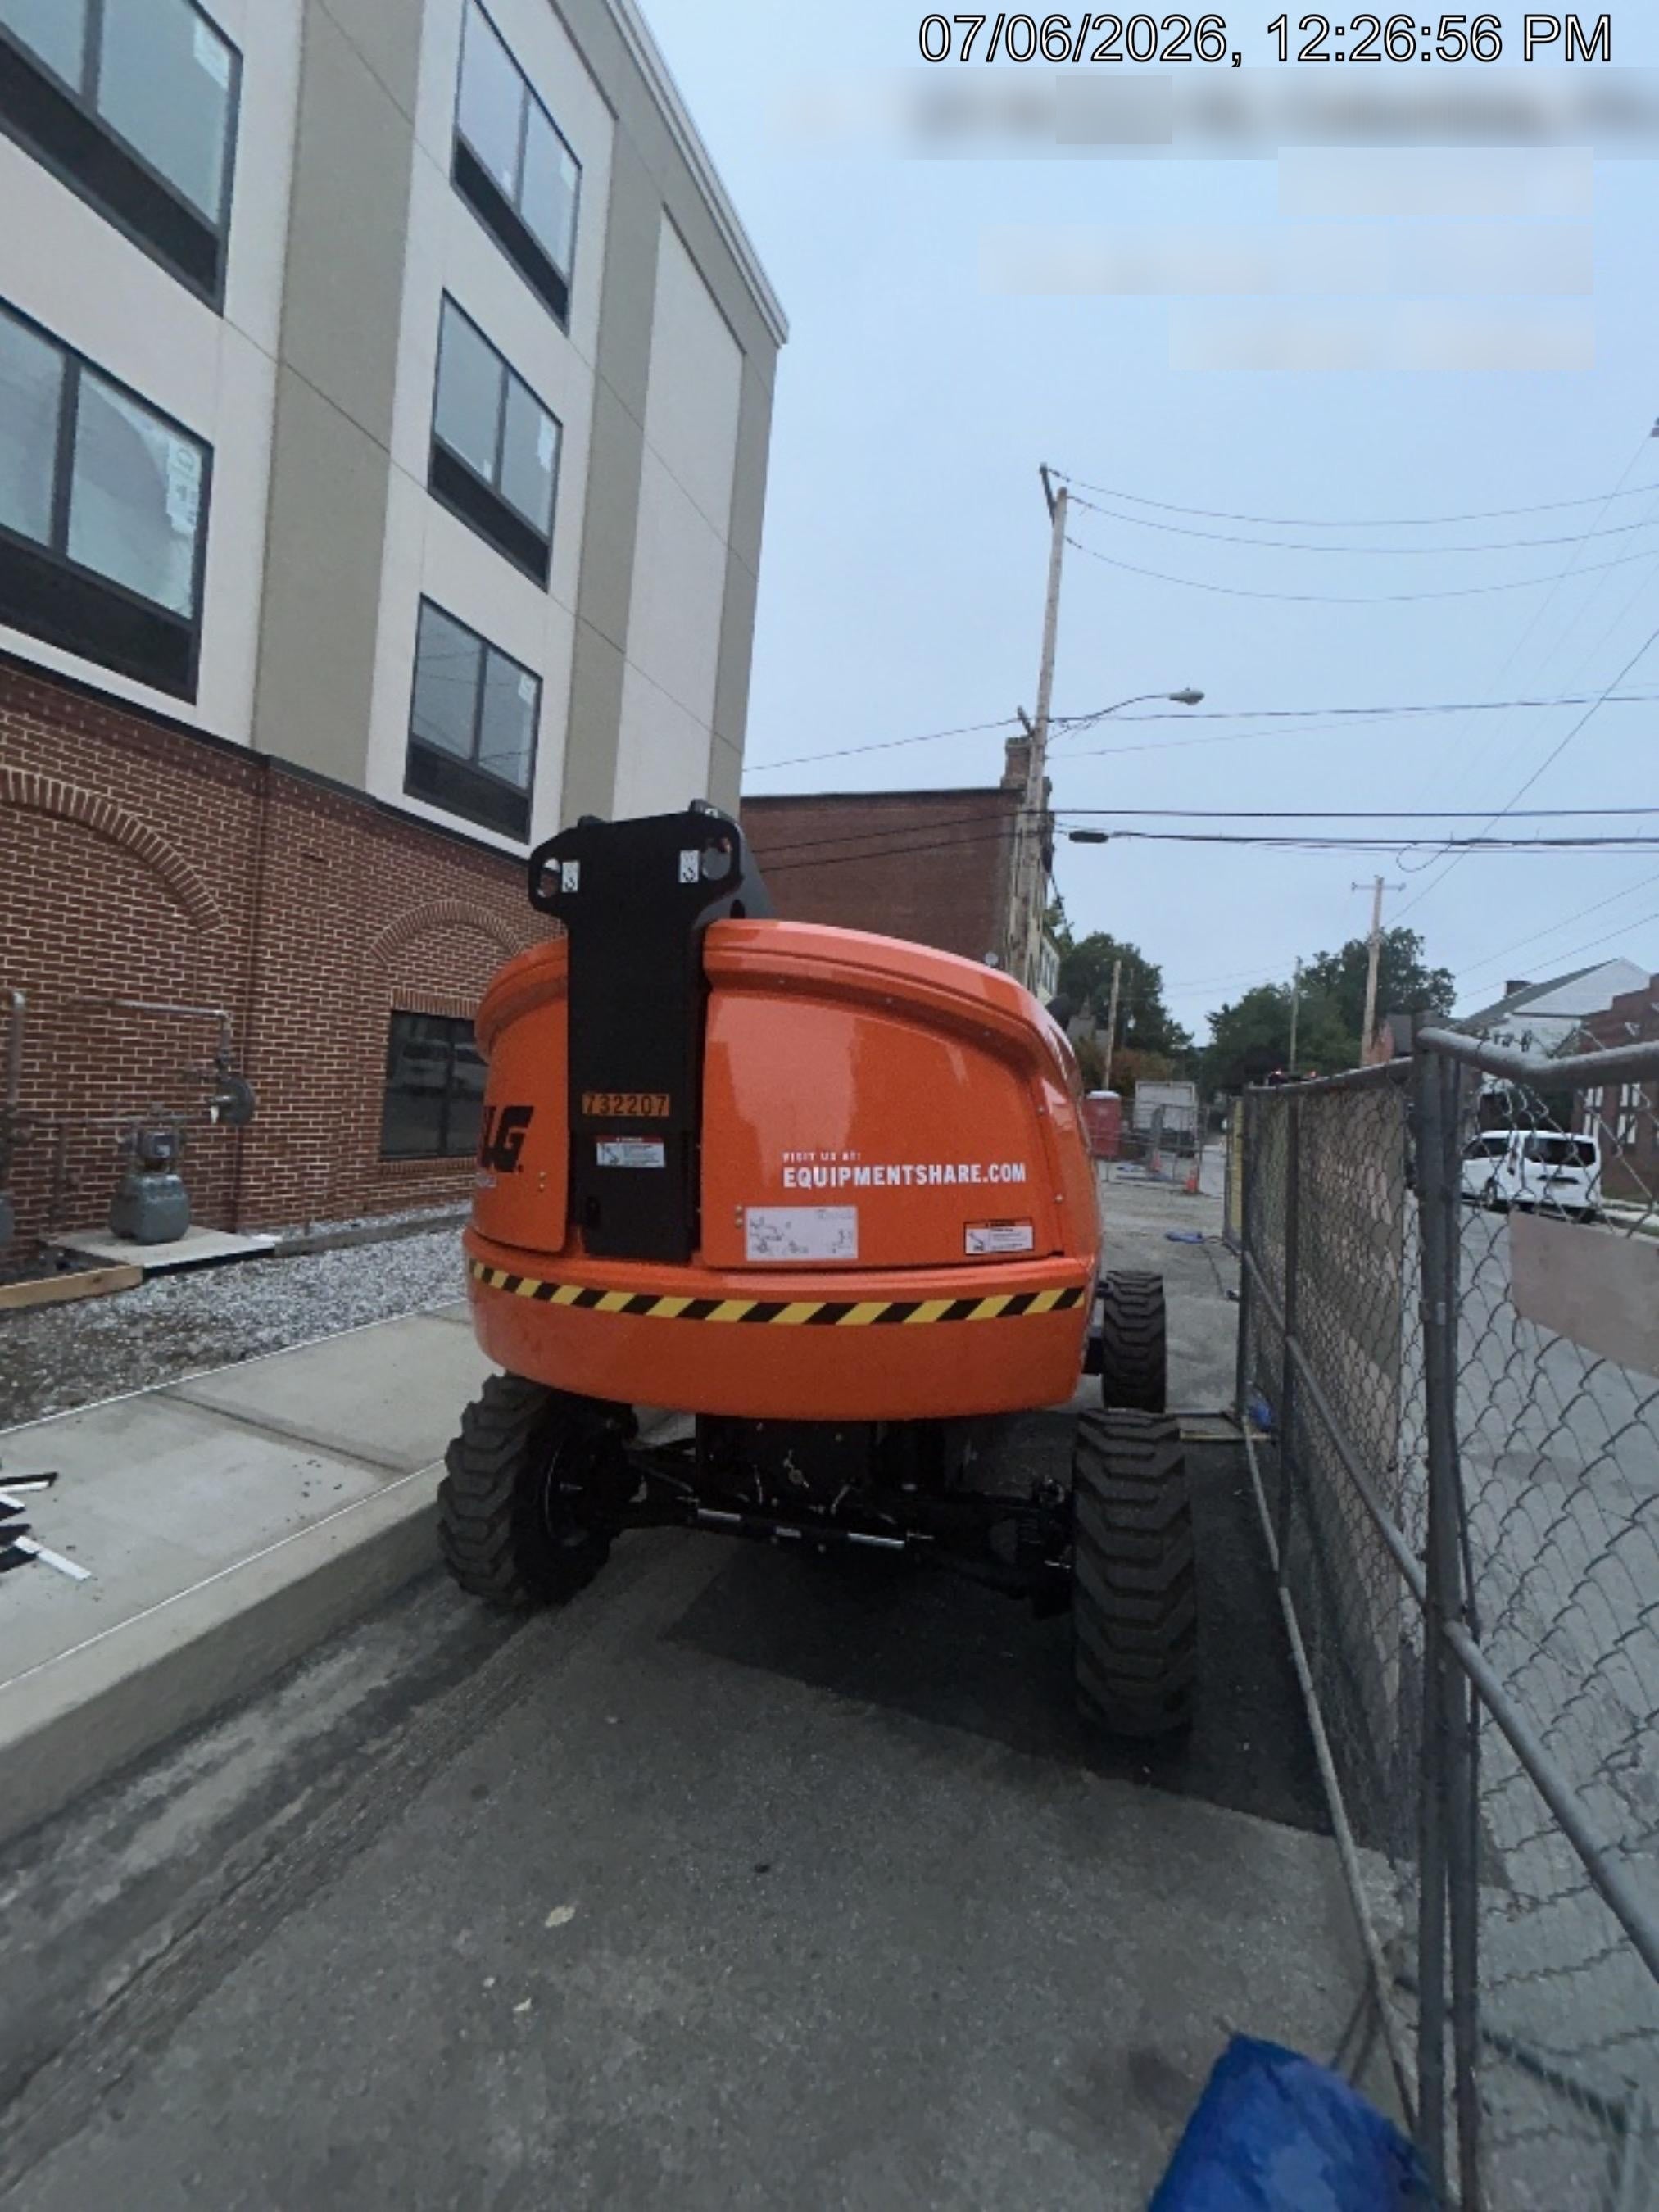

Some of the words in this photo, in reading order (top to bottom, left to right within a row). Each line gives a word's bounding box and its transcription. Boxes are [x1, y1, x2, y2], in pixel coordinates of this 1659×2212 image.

[586, 1094, 668, 1115] 732207
[480, 1105, 534, 1173] LG
[782, 1162, 1026, 1190] EQUIPMENTSHARE.COM
